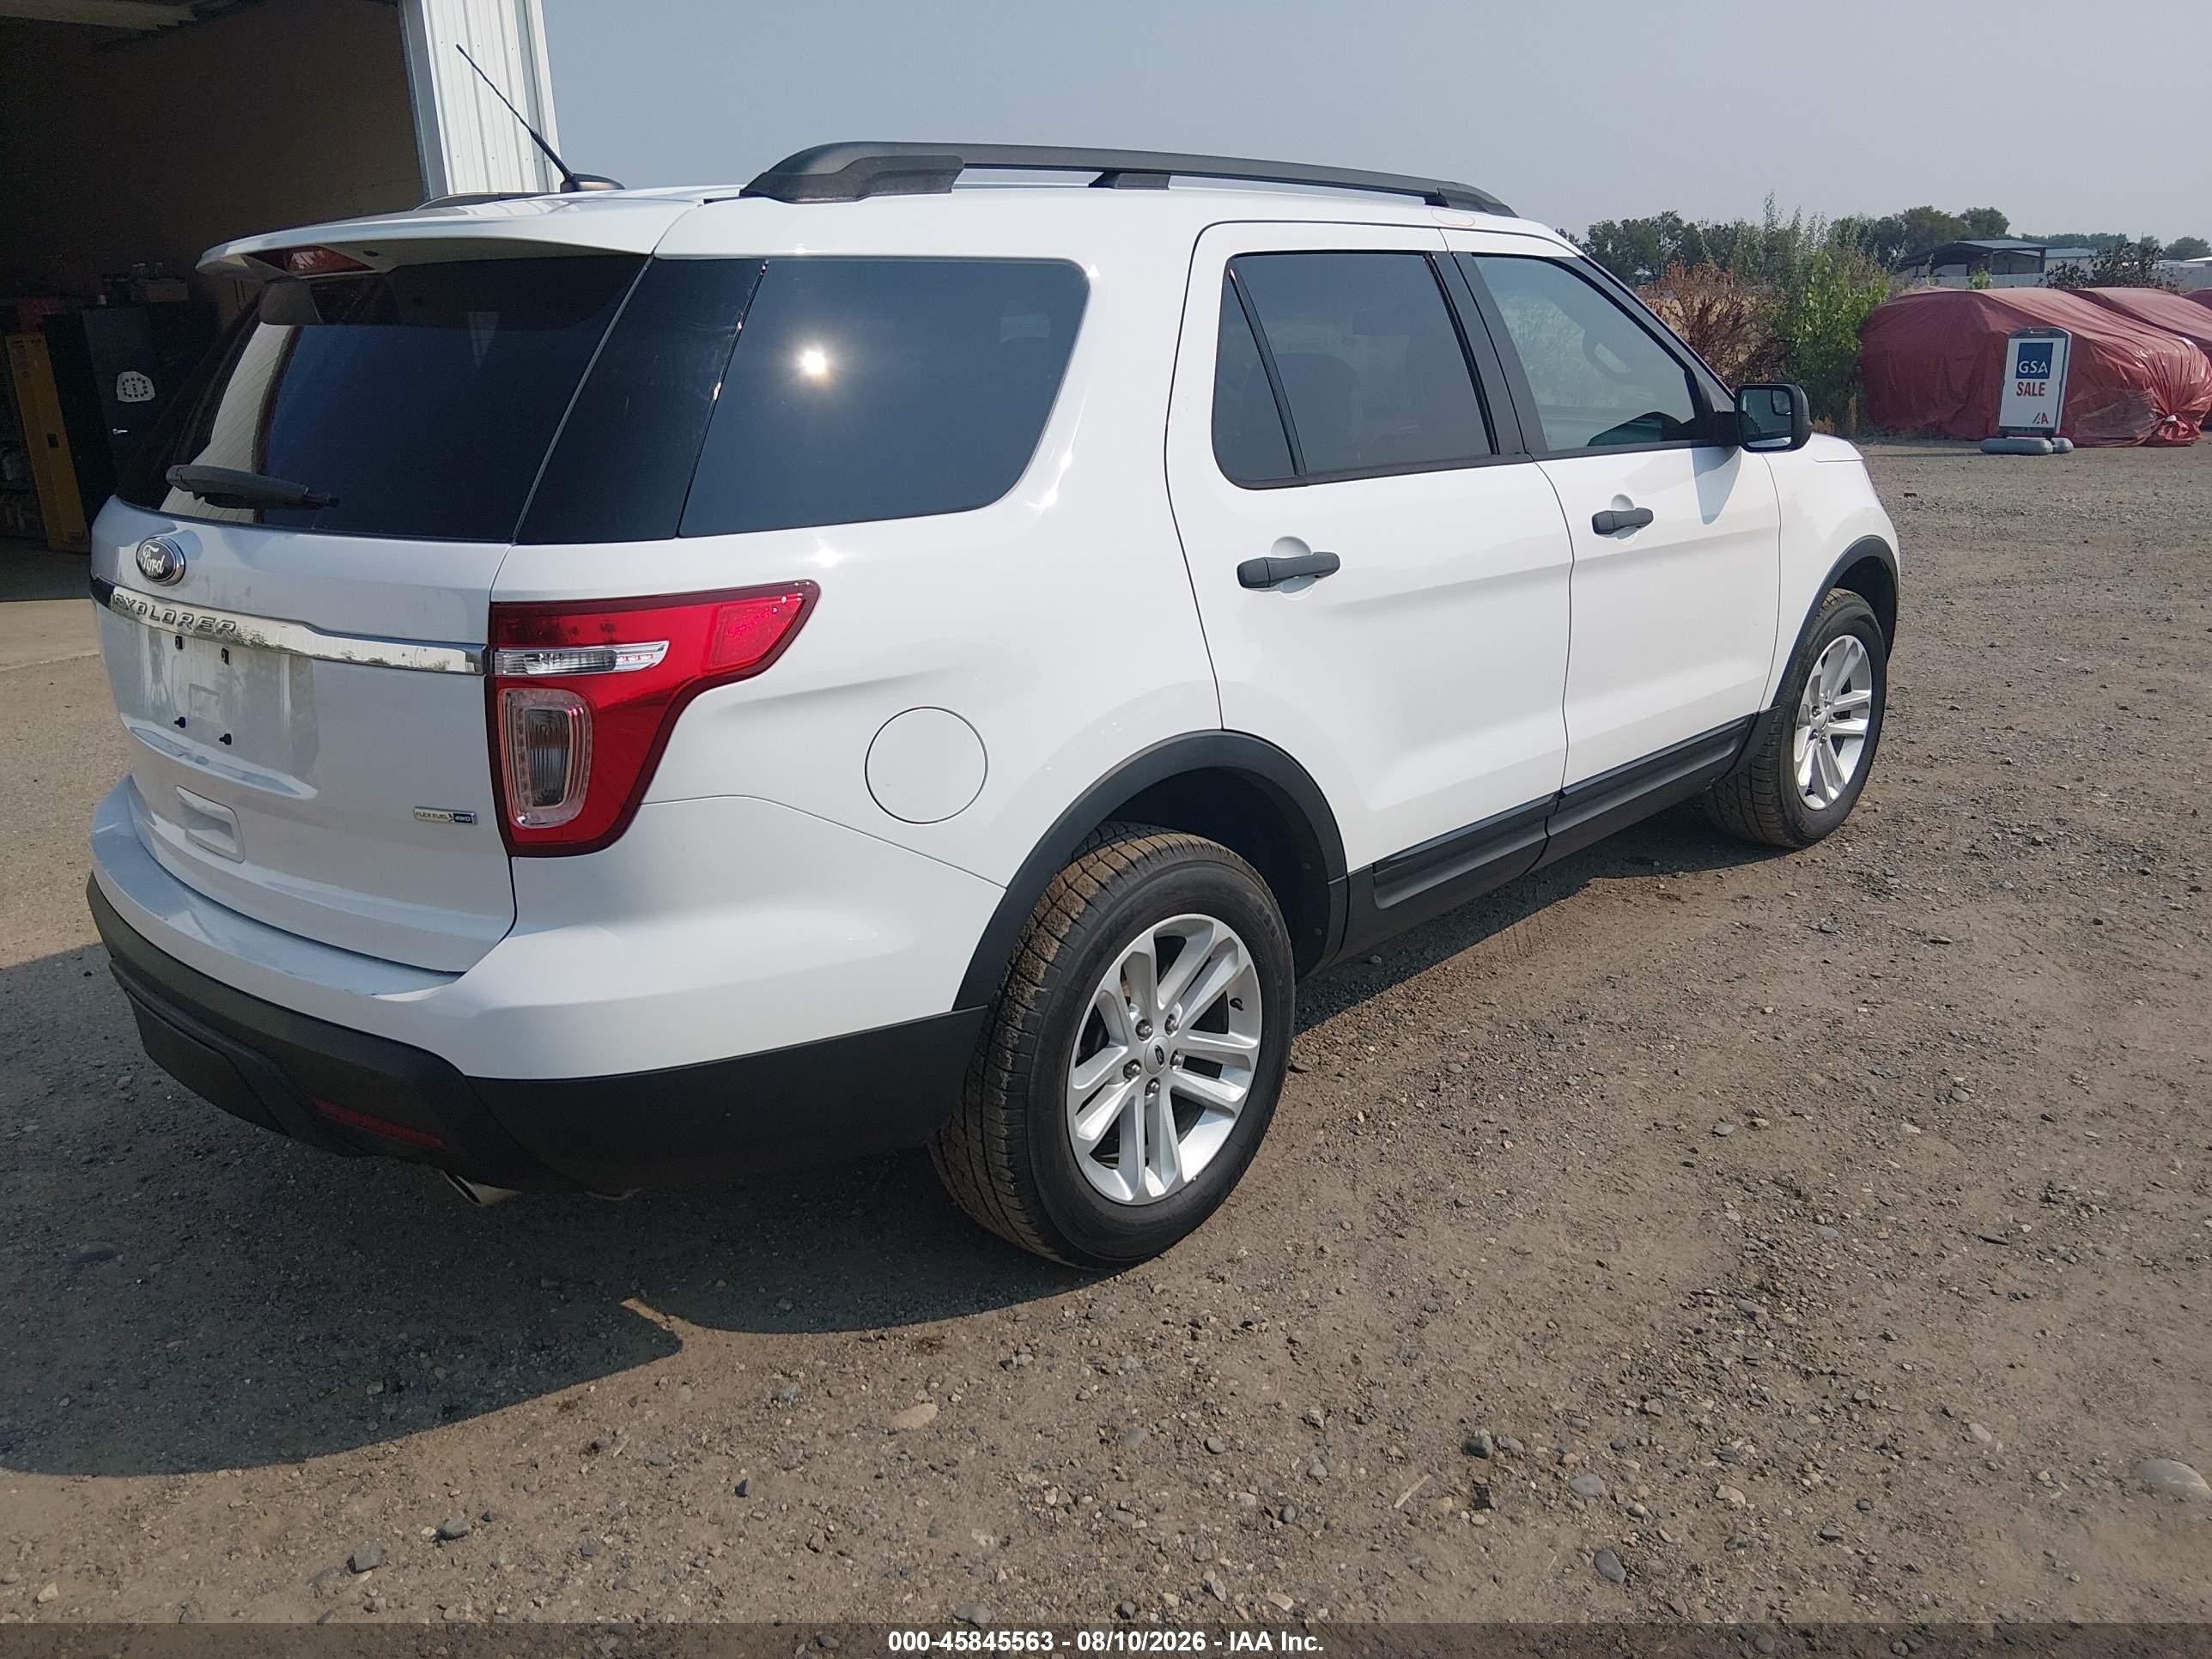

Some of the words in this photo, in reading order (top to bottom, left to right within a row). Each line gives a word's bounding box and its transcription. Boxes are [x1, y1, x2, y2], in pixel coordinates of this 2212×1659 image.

[2018, 360, 2048, 374] GSA
[2016, 381, 2046, 397] SALE
[140, 544, 166, 574] Ford
[114, 593, 237, 636] EXPLORER
